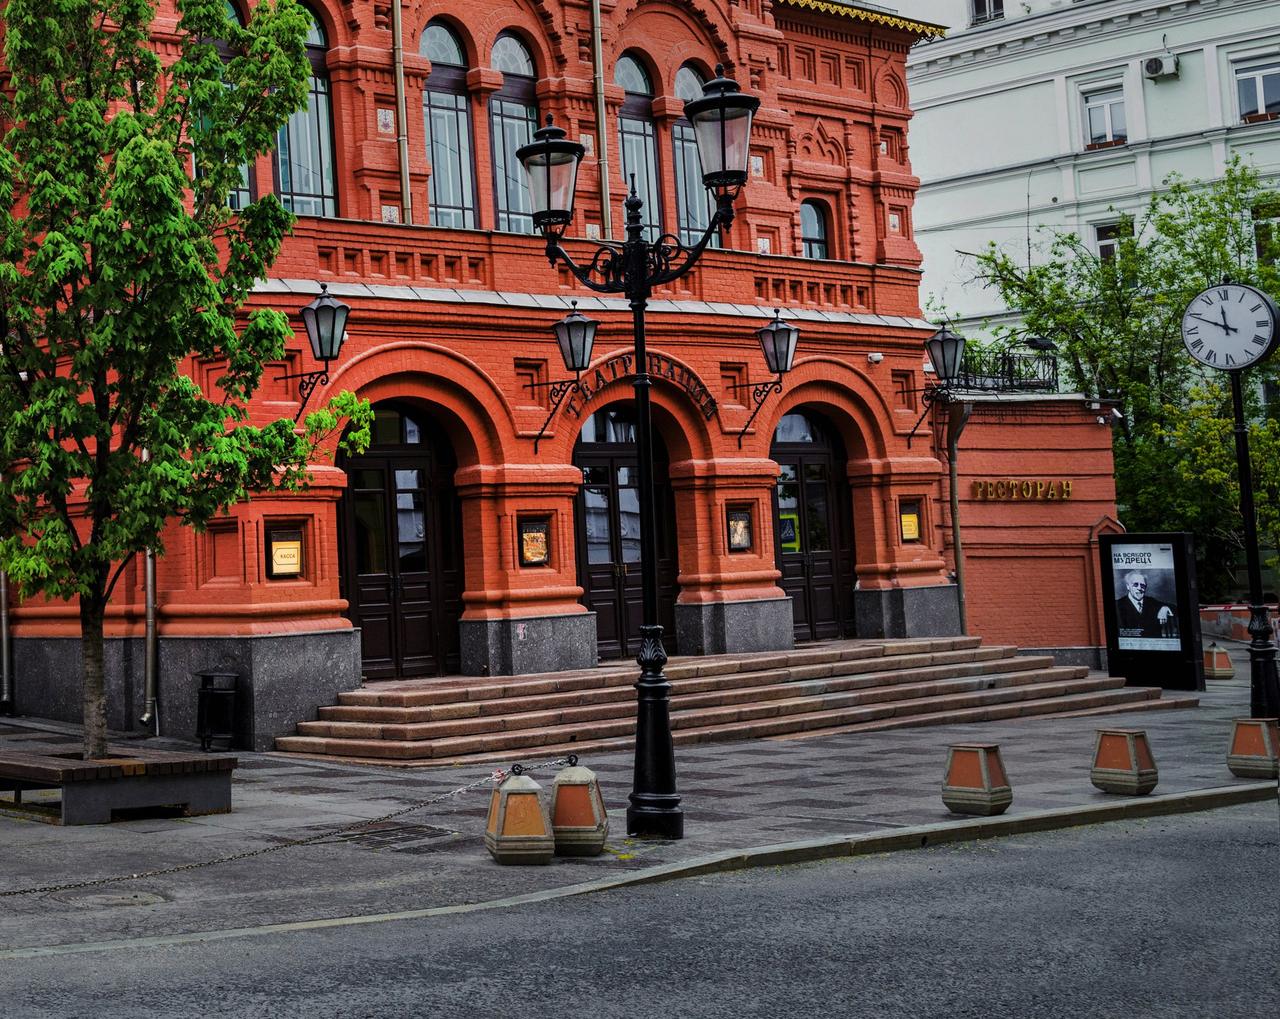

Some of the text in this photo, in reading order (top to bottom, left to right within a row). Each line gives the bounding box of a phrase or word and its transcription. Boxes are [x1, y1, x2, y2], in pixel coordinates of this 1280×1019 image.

[566, 354, 719, 421] ТЕАТР НАЦИЙ
[974, 481, 1073, 499] РЕСТОРАН
